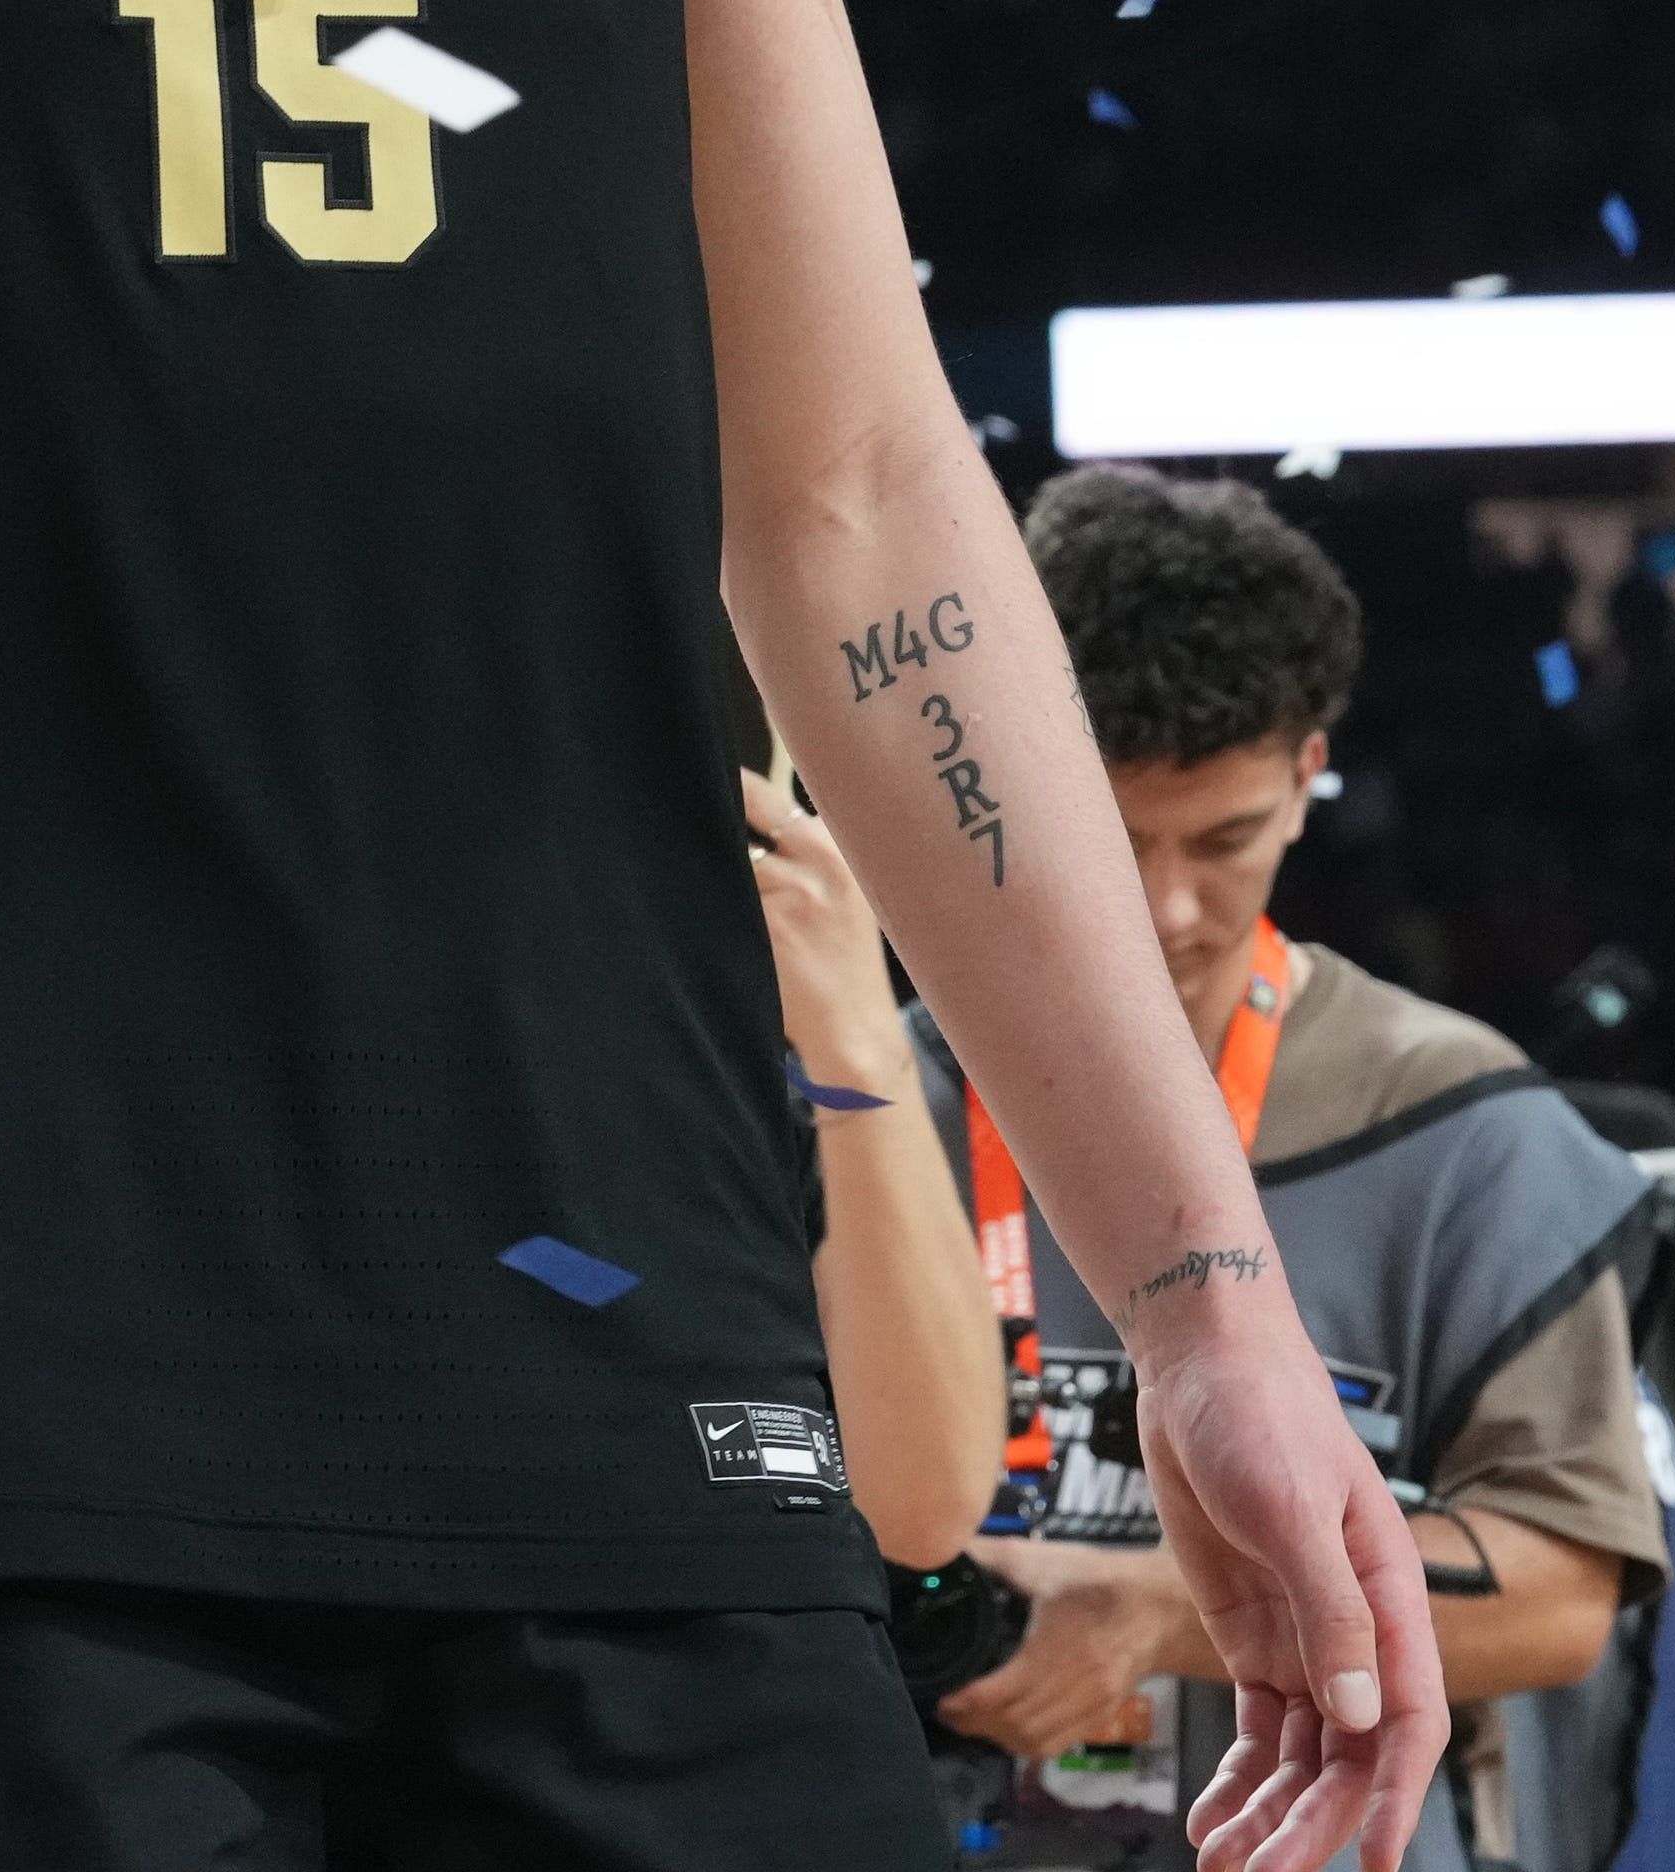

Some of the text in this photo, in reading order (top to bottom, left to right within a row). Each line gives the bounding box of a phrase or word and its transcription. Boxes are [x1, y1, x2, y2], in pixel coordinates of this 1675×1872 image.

[839, 591, 975, 703] M4G
[921, 694, 964, 761] 3
[938, 758, 1001, 830] R
[969, 818, 1004, 887] 7
[712, 1449, 759, 1462] TEAM
